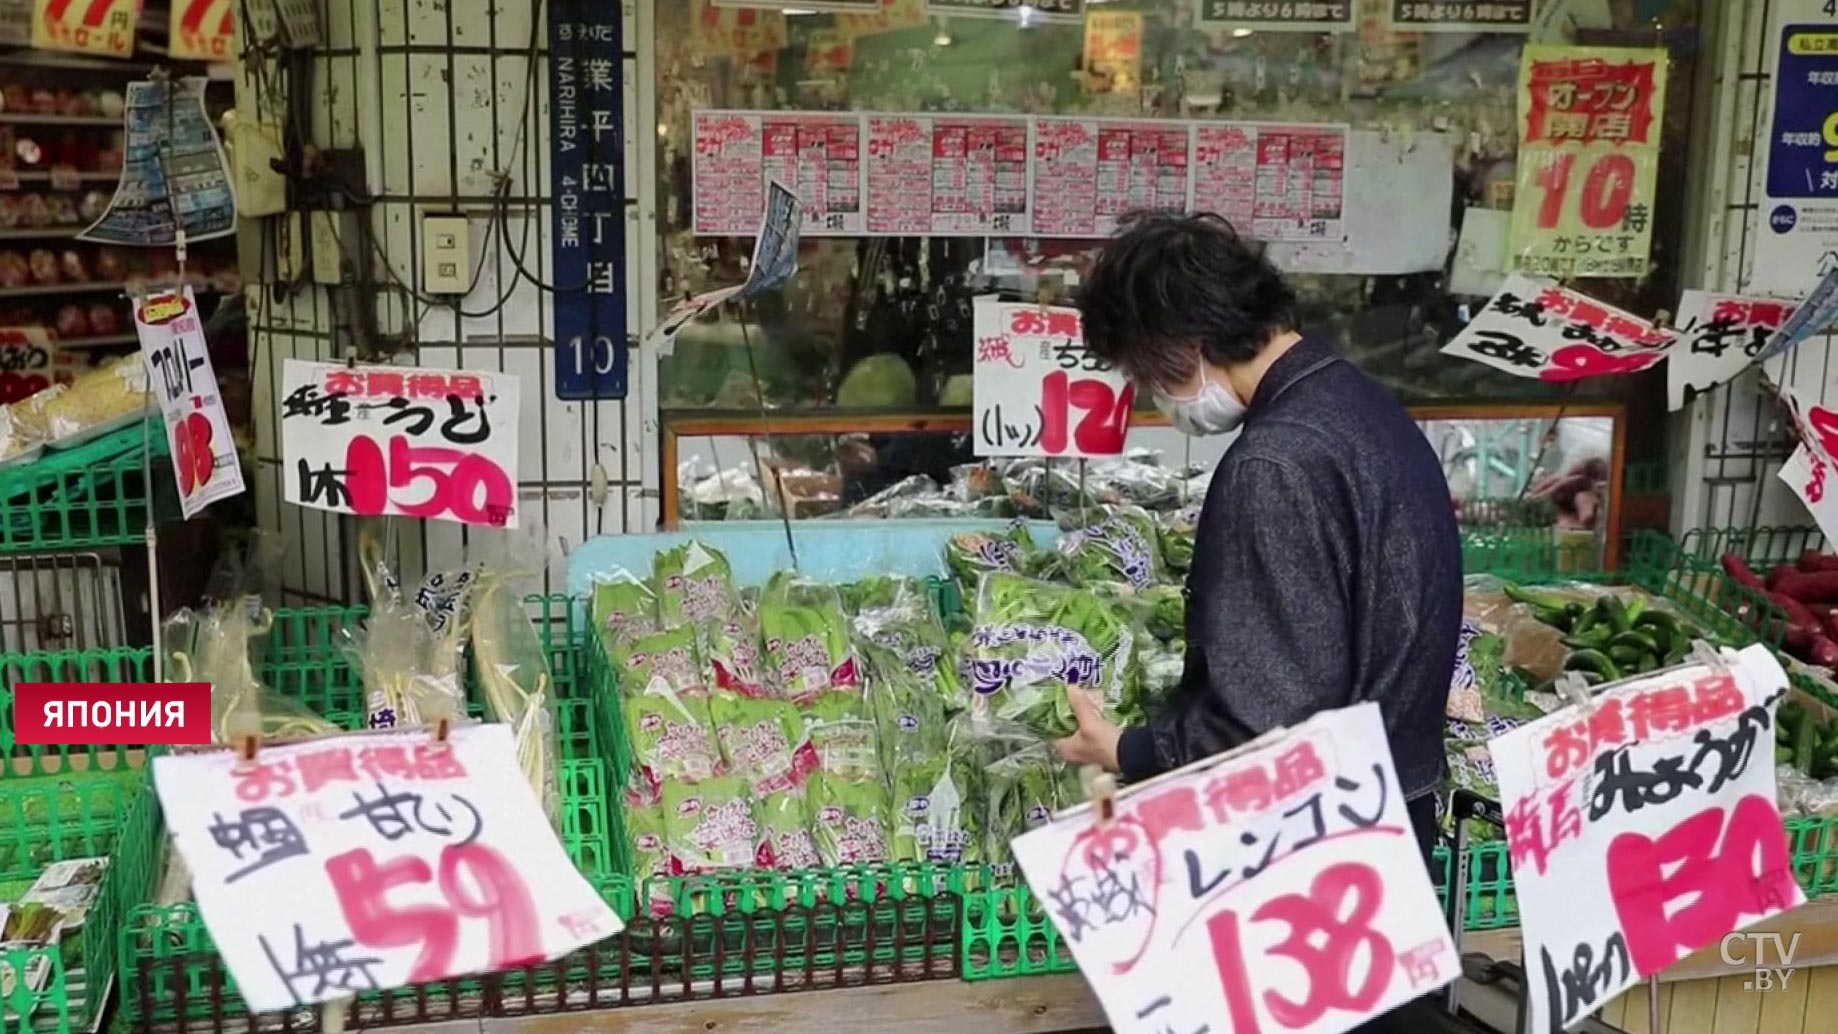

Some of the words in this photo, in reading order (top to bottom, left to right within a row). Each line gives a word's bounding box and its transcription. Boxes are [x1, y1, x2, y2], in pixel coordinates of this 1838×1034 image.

[558, 57, 577, 152] NARIHIRA
[1547, 79, 1638, 111] オープン
[569, 335, 615, 376] 10
[346, 434, 513, 524] 150
[231, 745, 468, 801] お買得品
[1543, 674, 1746, 779] お買得品
[1184, 763, 1387, 899] レンコン
[325, 844, 548, 983] 59
[1207, 861, 1396, 1034] 138
